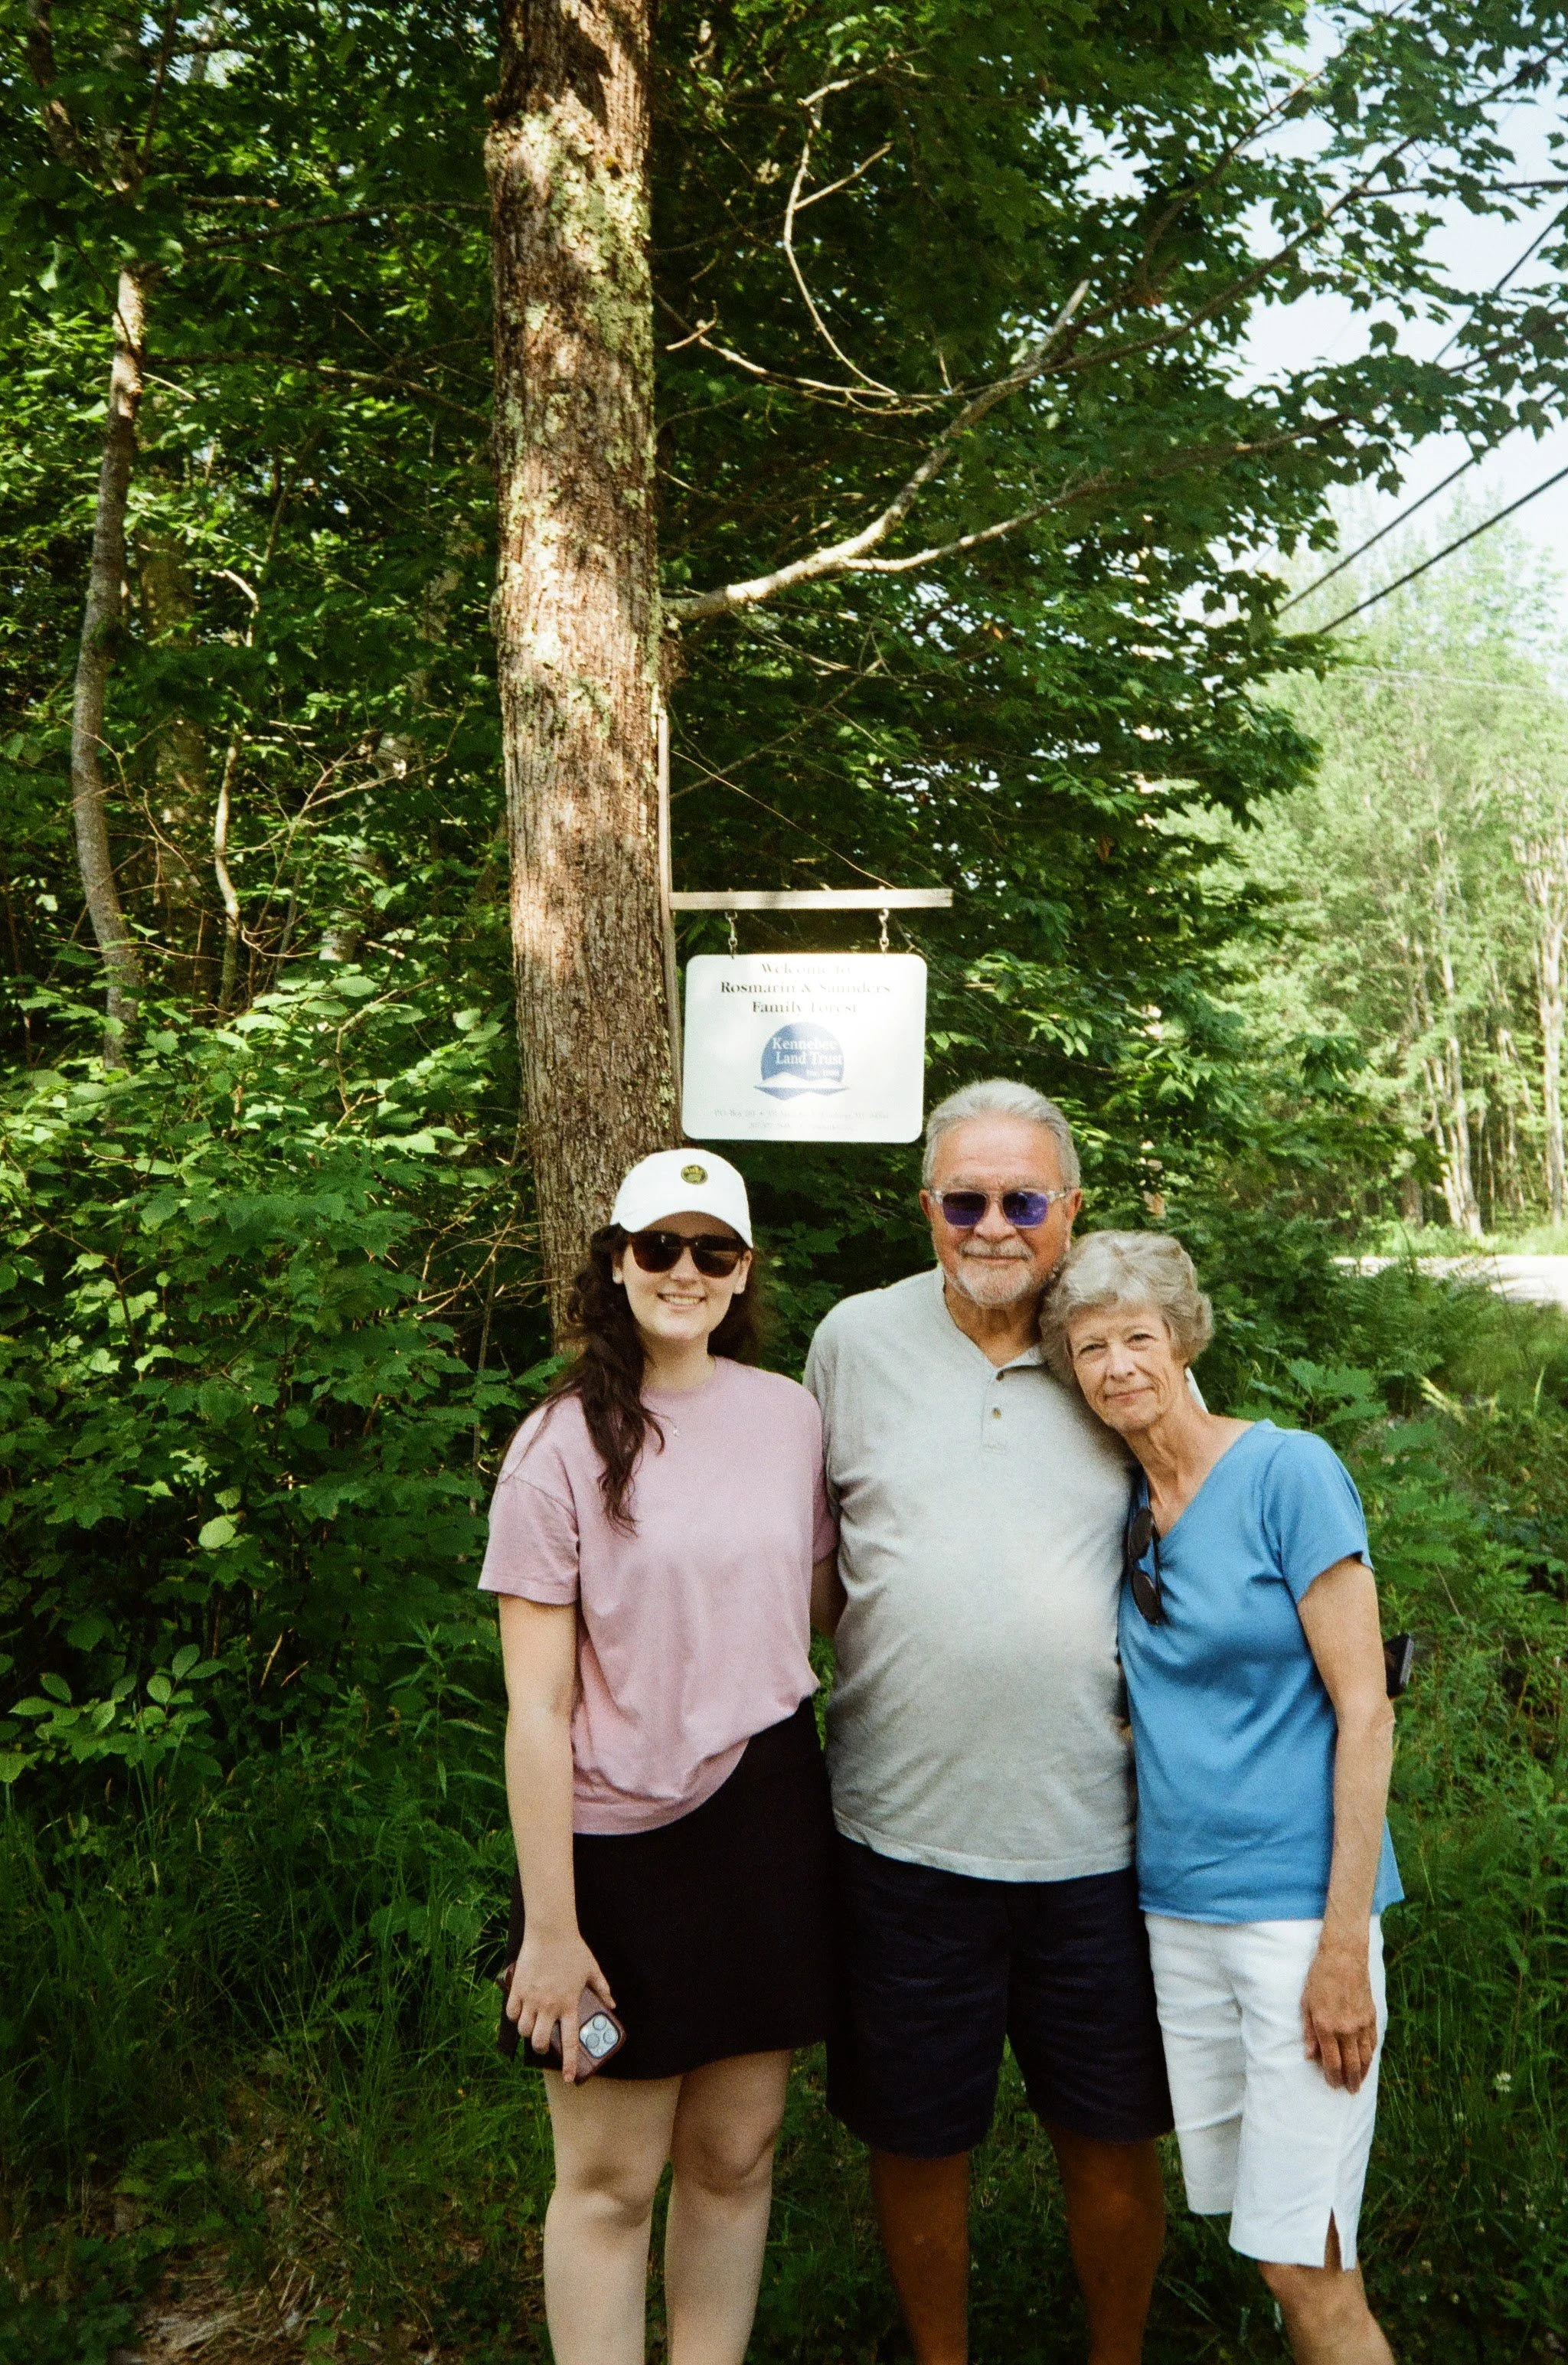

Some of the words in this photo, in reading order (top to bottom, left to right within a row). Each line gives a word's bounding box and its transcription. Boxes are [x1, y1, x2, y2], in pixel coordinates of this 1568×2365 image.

[760, 962, 828, 975] Welcome
[720, 981, 795, 994] Rosmarin
[801, 982, 812, 994] &
[752, 1001, 802, 1016] Family
[772, 1037, 837, 1050] Kennebec
[775, 1051, 807, 1065] Land
[809, 1051, 844, 1065] Trust
